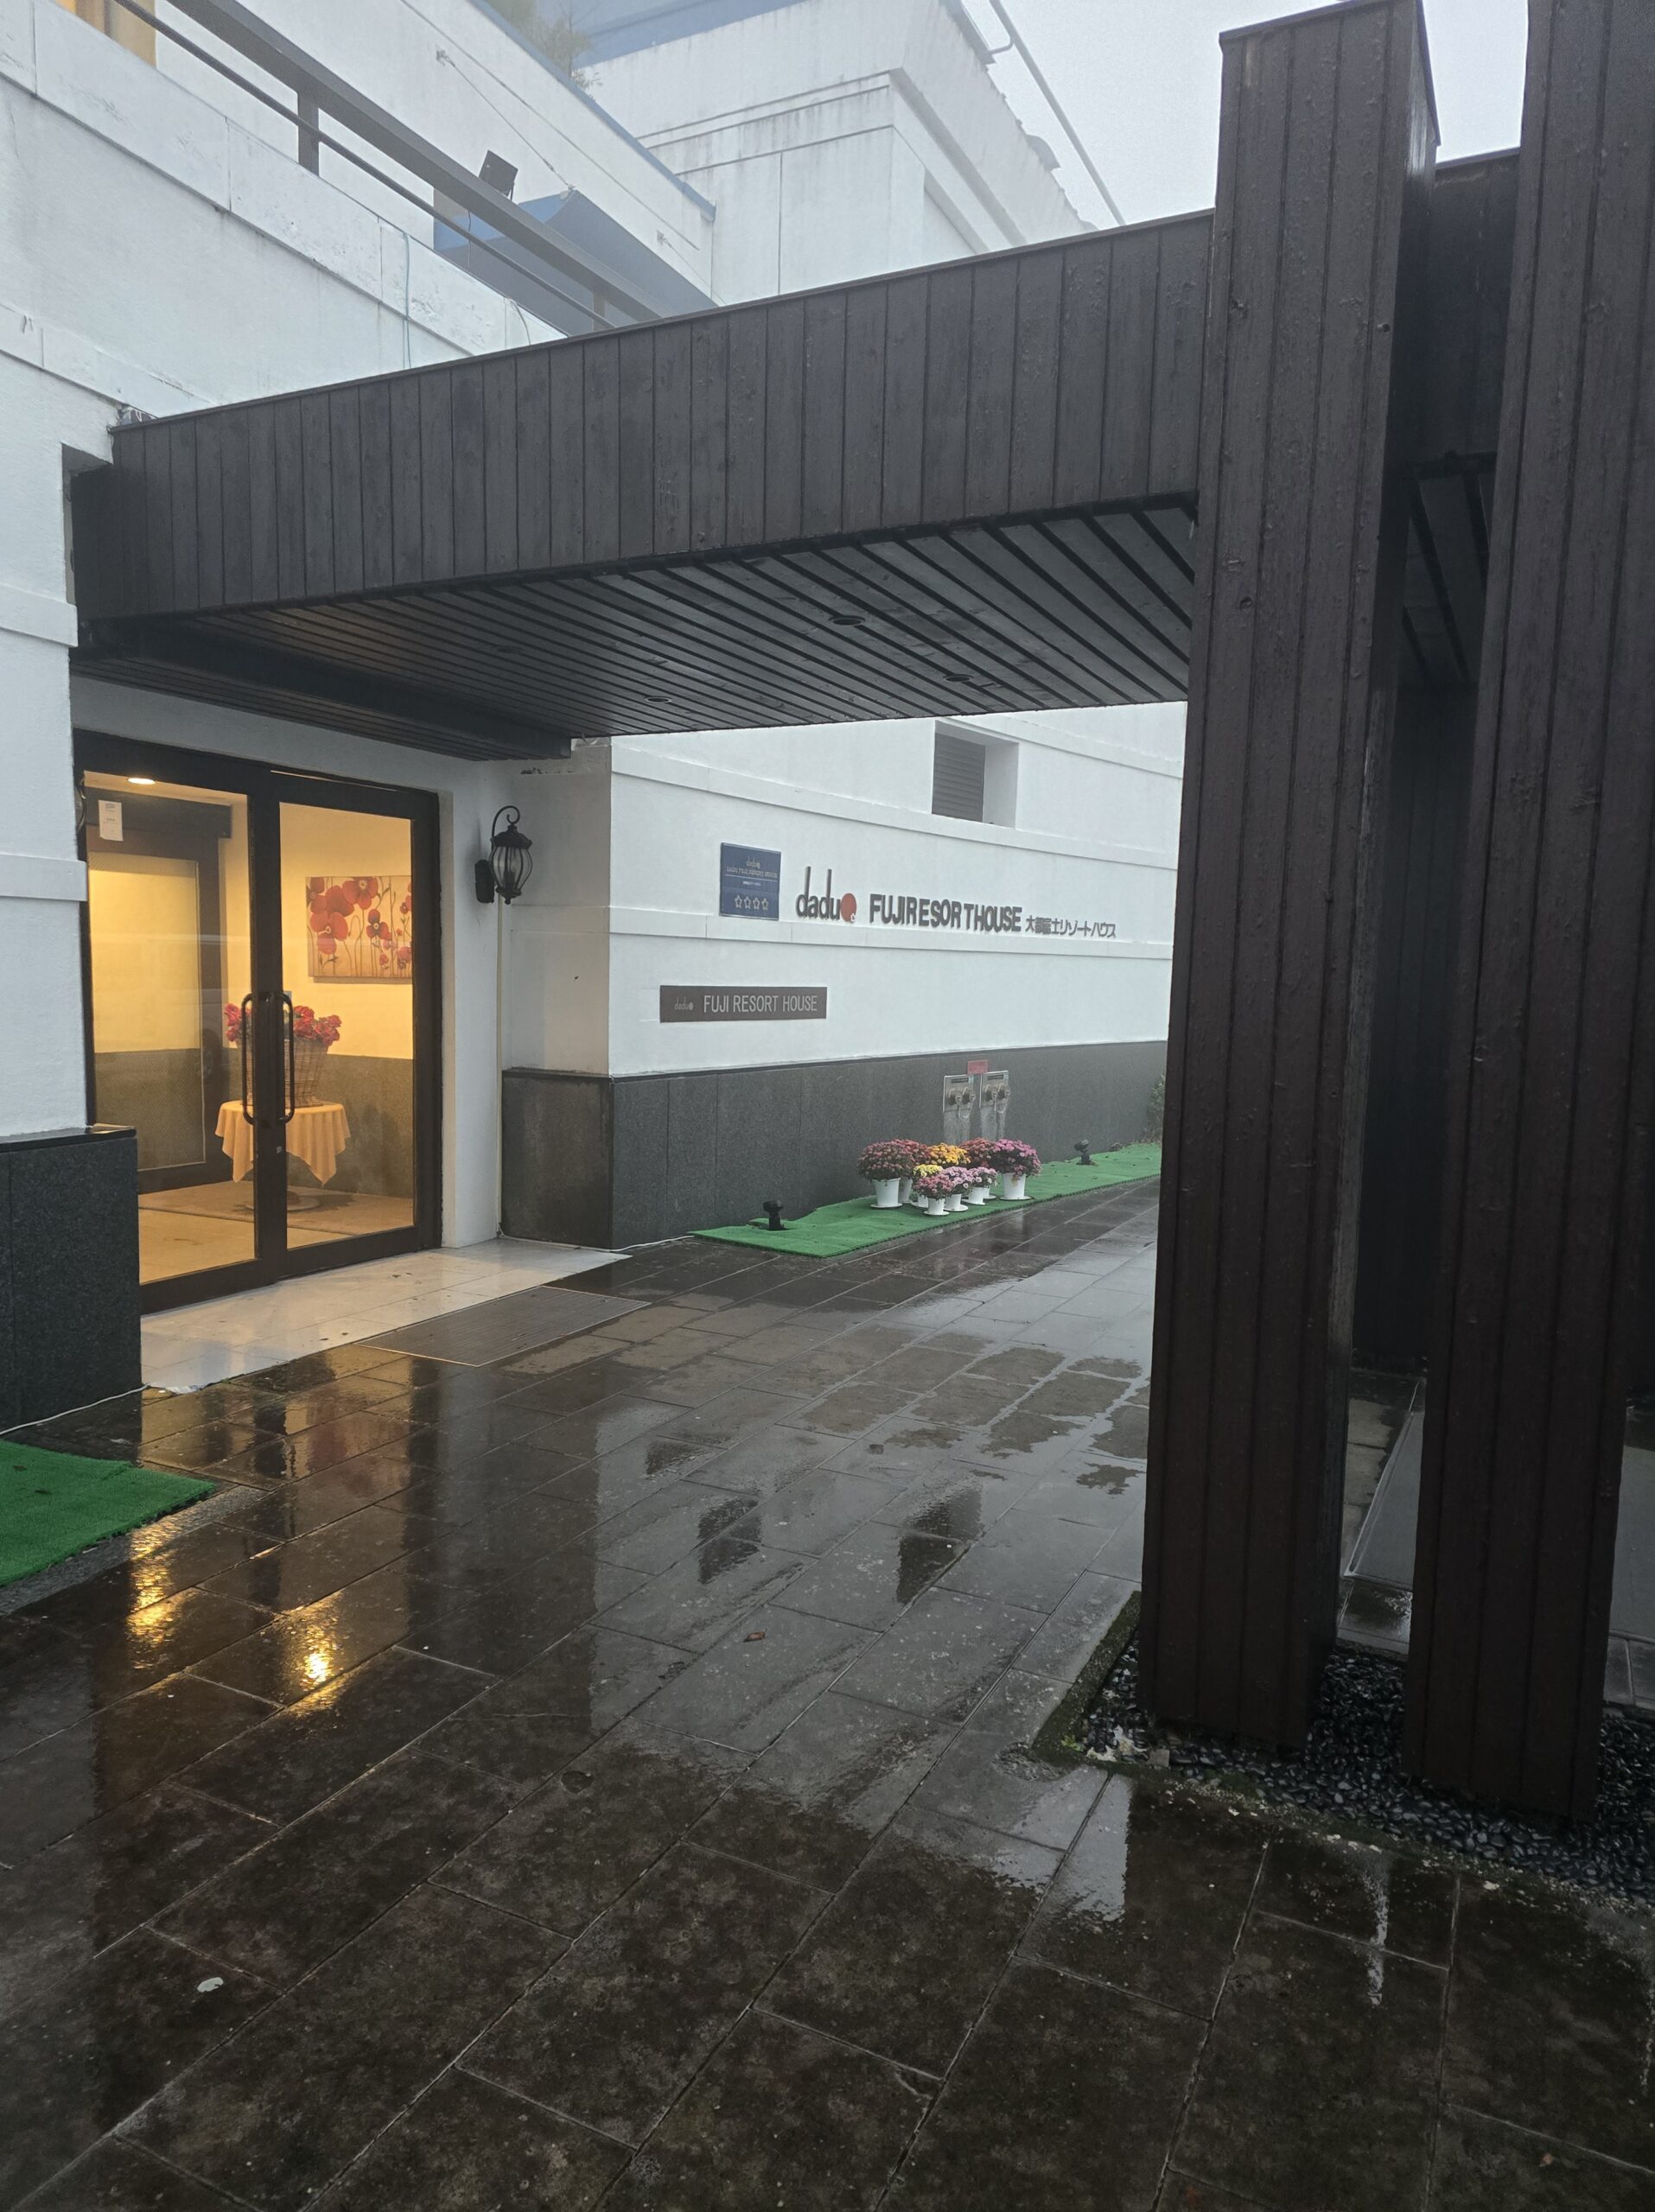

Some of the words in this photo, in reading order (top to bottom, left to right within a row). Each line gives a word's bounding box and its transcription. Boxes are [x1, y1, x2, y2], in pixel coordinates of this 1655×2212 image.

[703, 995, 729, 1013] FUJI
[733, 995, 779, 1013] RESORT
[782, 995, 818, 1012] HOUSE
